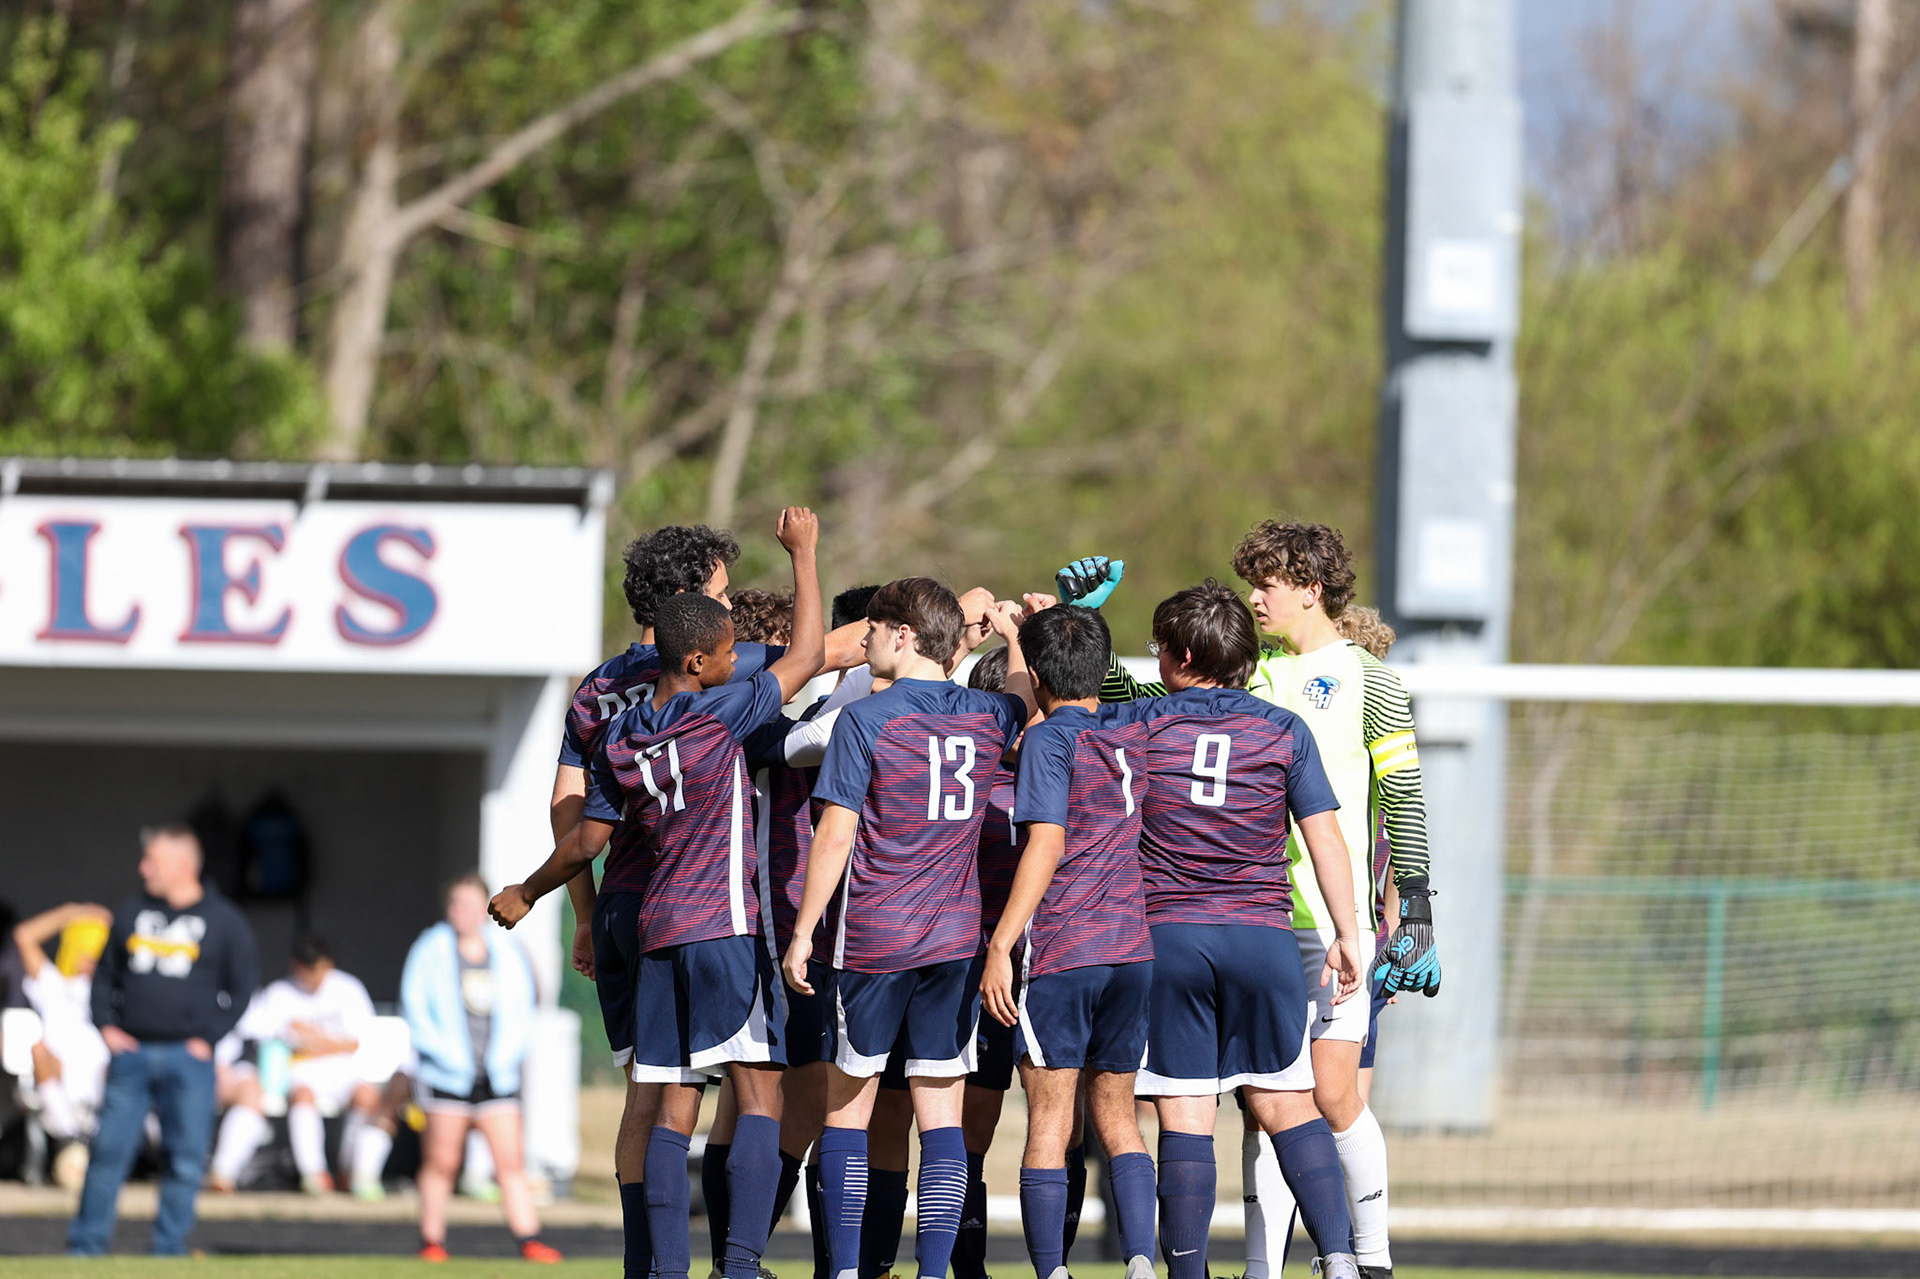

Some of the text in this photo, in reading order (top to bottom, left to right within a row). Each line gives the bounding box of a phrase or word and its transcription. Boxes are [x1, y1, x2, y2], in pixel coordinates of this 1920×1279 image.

[927, 735, 976, 821] 13
[1190, 733, 1232, 807] 9
[1401, 898, 1409, 916] EPIC
[1390, 935, 1415, 960] GK
